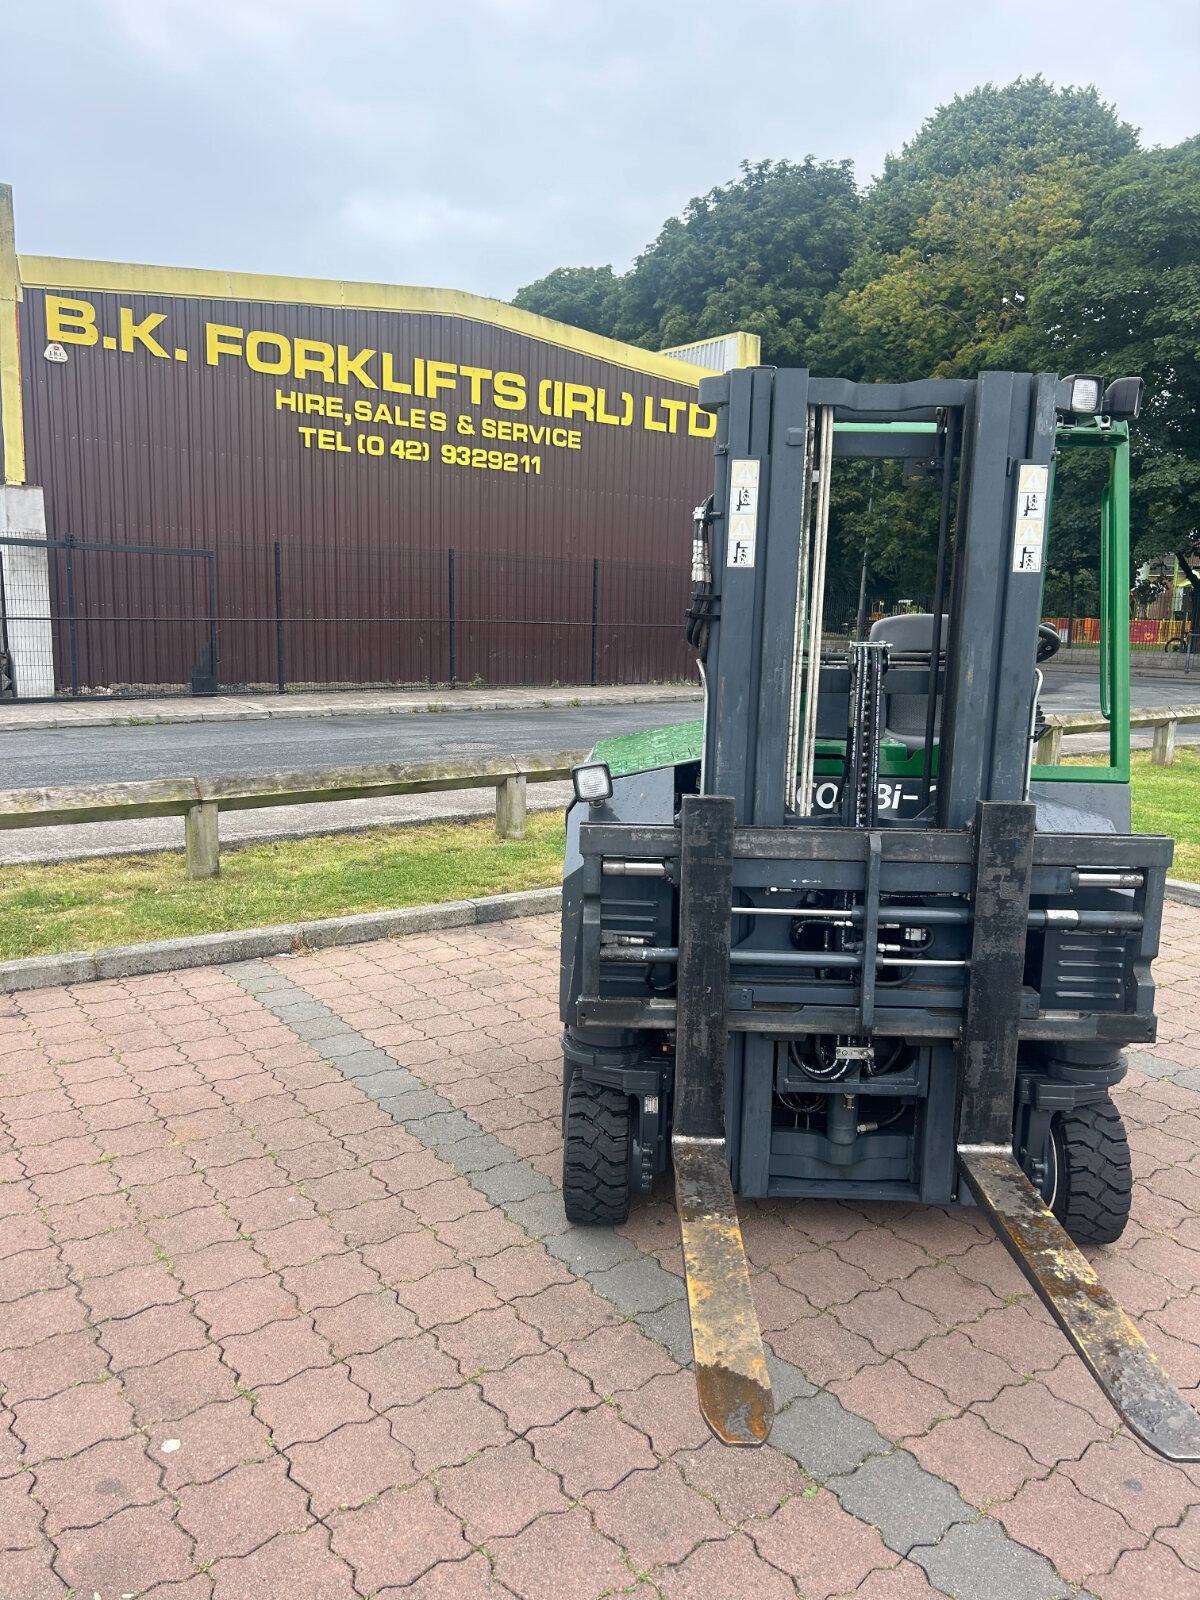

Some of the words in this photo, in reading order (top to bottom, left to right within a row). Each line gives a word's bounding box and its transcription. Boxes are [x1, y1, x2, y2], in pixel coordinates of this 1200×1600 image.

[45, 294, 188, 361] B.K.
[205, 322, 527, 411] FORKLIFTS
[538, 378, 634, 427] (IRL)
[644, 395, 718, 438] LTD
[298, 426, 352, 453] TEL
[440, 443, 541, 475] 9329211
[456, 414, 476, 435] &
[481, 417, 582, 450] SERVICE
